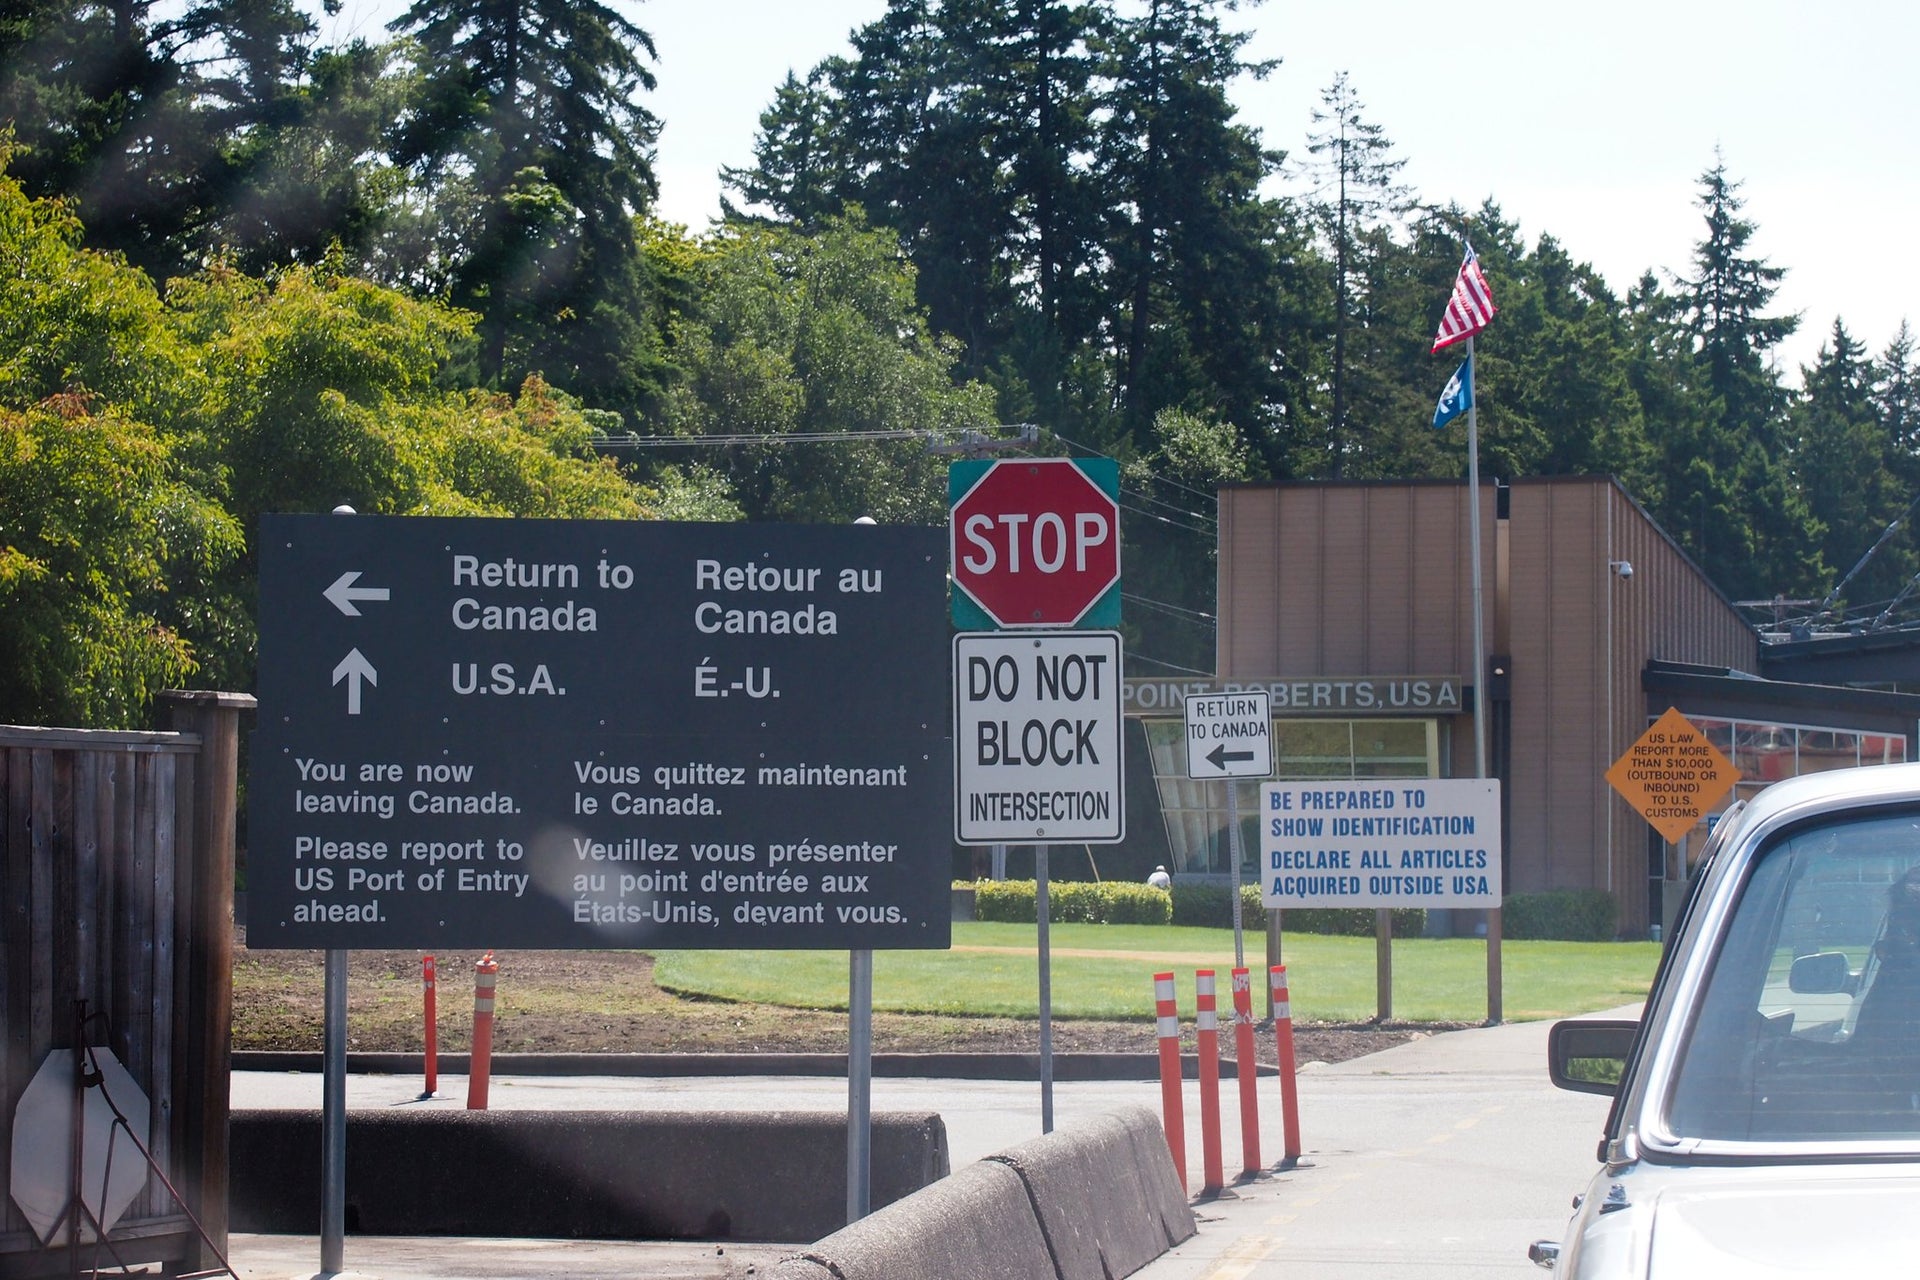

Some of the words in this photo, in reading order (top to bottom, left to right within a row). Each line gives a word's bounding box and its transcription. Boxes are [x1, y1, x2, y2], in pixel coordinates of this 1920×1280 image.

[962, 512, 1108, 576] STOP
[453, 555, 579, 588] Return
[597, 558, 635, 590] to
[696, 559, 821, 592] Retour
[838, 568, 882, 593] au
[452, 598, 597, 632] Canada
[694, 602, 838, 635] Canada
[452, 663, 567, 695] U.S.A.
[695, 657, 781, 698] É.-U.
[968, 656, 1019, 702] DO
[1036, 655, 1107, 701] NOT
[1390, 681, 1457, 707] USA
[1197, 699, 1258, 717] RETURN
[977, 719, 1100, 766] BLOCK
[1190, 723, 1206, 740] TO
[1213, 721, 1267, 739] CANADA
[1649, 734, 1665, 743] US
[1670, 734, 1694, 743] LAW
[1631, 758, 1661, 768] THAN
[1666, 758, 1713, 769] $10,000
[1634, 746, 1674, 756] REPORT
[1680, 746, 1709, 756] MORE
[295, 758, 346, 781] You
[359, 764, 403, 782] are
[416, 764, 474, 782] now
[574, 761, 641, 784] Vous
[654, 763, 746, 789] quittez
[758, 763, 907, 786] maintenant
[1627, 770, 1695, 781] (OUTBOUND
[1700, 771, 1717, 780] OR
[1270, 791, 1292, 810] BE
[1301, 790, 1394, 810] PREPARED
[1403, 789, 1425, 808] TO
[1643, 783, 1700, 793] INBOUND)
[1652, 795, 1666, 805] TO
[1671, 795, 1693, 805] U.S.
[295, 790, 395, 819] leaving
[408, 791, 521, 814] Canada.
[574, 792, 598, 814] le
[611, 792, 722, 815] Canada.
[969, 791, 1110, 822] INTERSECTION
[1645, 808, 1699, 818] CUSTOMS
[1271, 818, 1323, 837] SHOW
[1332, 816, 1475, 836] IDENTIFICATION
[295, 837, 388, 860] Please
[401, 839, 484, 866] report
[497, 839, 524, 860] to
[573, 838, 679, 861] Veuillez
[691, 843, 756, 862] vous
[769, 838, 898, 867] présenter
[1271, 850, 1350, 870] DECLARE
[1360, 850, 1391, 869] ALL
[1400, 850, 1487, 869] ARTICLES
[295, 868, 334, 891] US
[348, 868, 405, 891] Port
[417, 868, 445, 891] of
[458, 868, 529, 897] Entry
[573, 873, 606, 891] au
[620, 870, 688, 897] point
[700, 869, 809, 893] d'entrée
[821, 874, 869, 893] aux
[1272, 876, 1360, 898] ACQUIRED
[1369, 875, 1444, 896] OUTSIDE
[294, 900, 386, 922] ahead.
[573, 894, 720, 928] États-Unis,
[733, 902, 824, 924] devant
[836, 906, 908, 924] vous.
